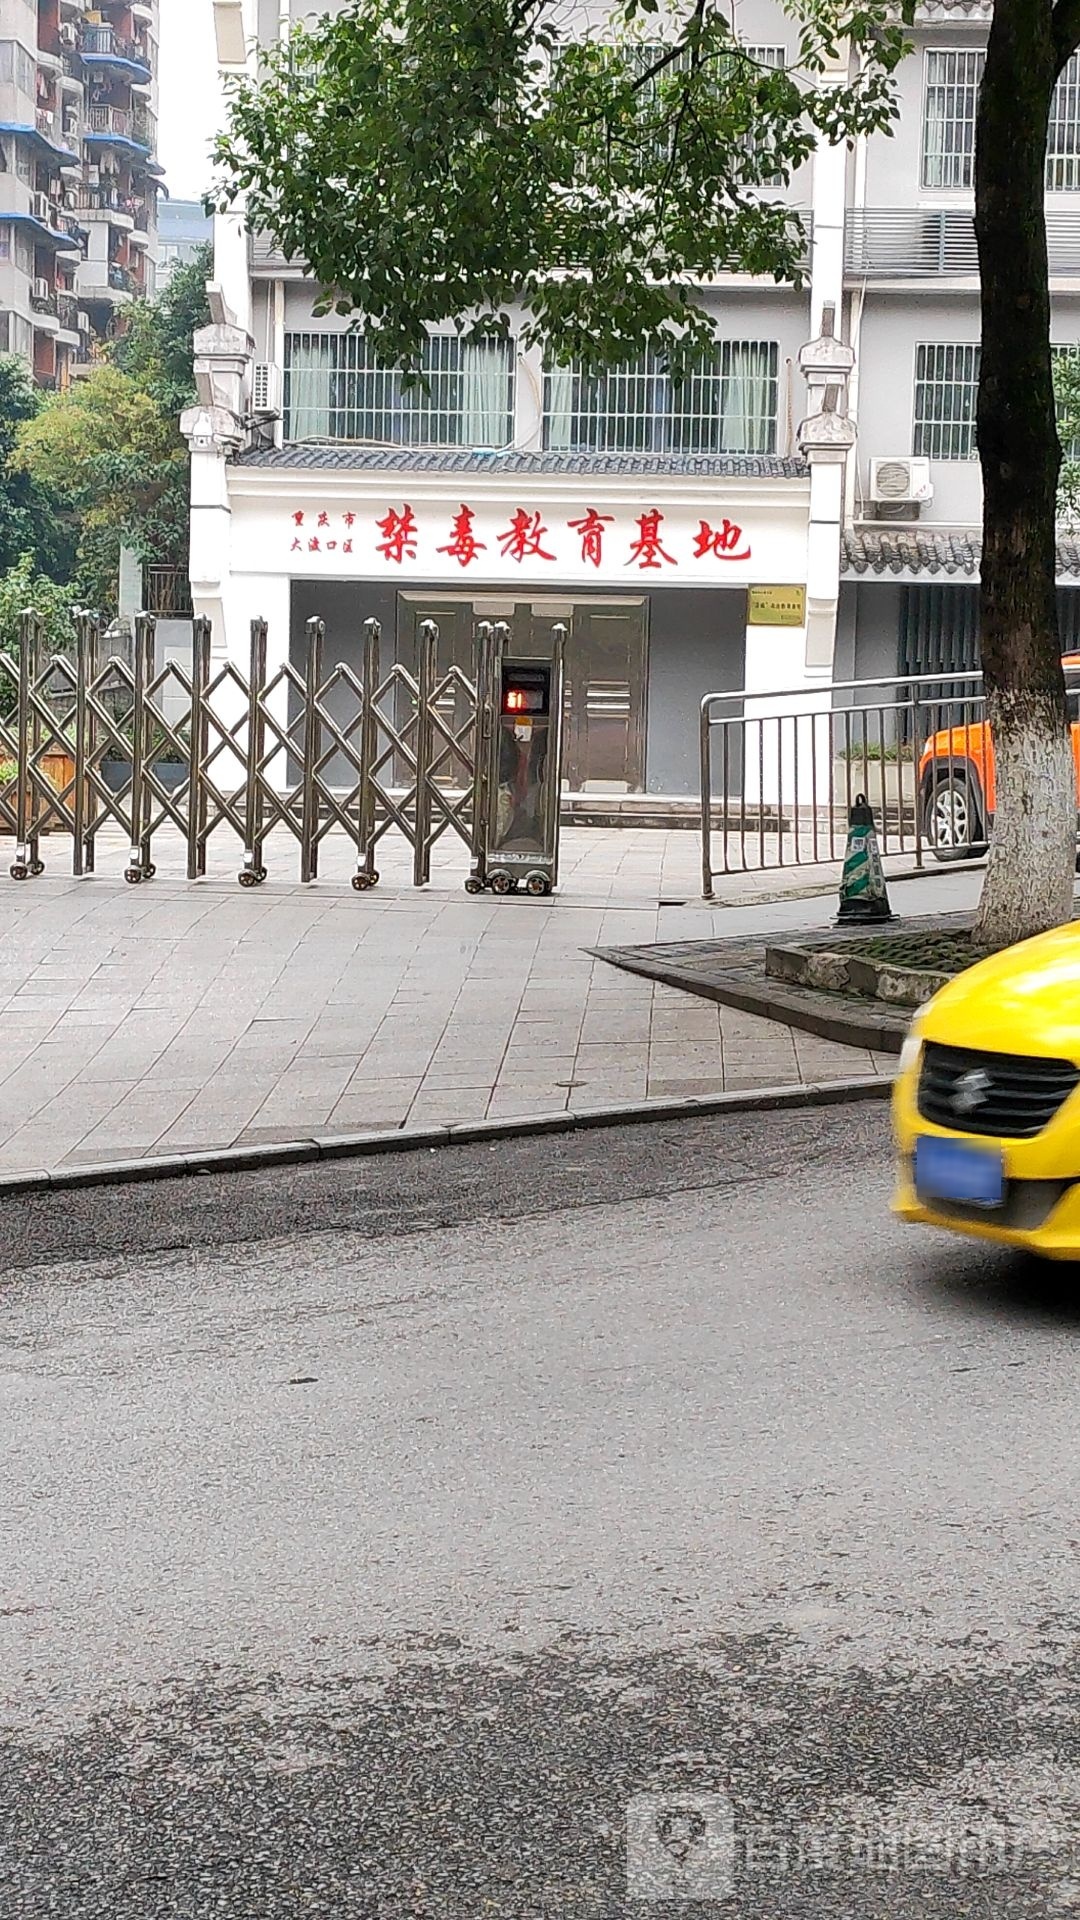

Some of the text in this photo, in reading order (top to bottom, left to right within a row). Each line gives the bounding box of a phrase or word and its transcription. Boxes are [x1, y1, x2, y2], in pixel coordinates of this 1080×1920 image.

[291, 510, 357, 530] 重庆市
[290, 536, 354, 553] 大渡口区
[375, 503, 752, 569] 禁毒教育基地
